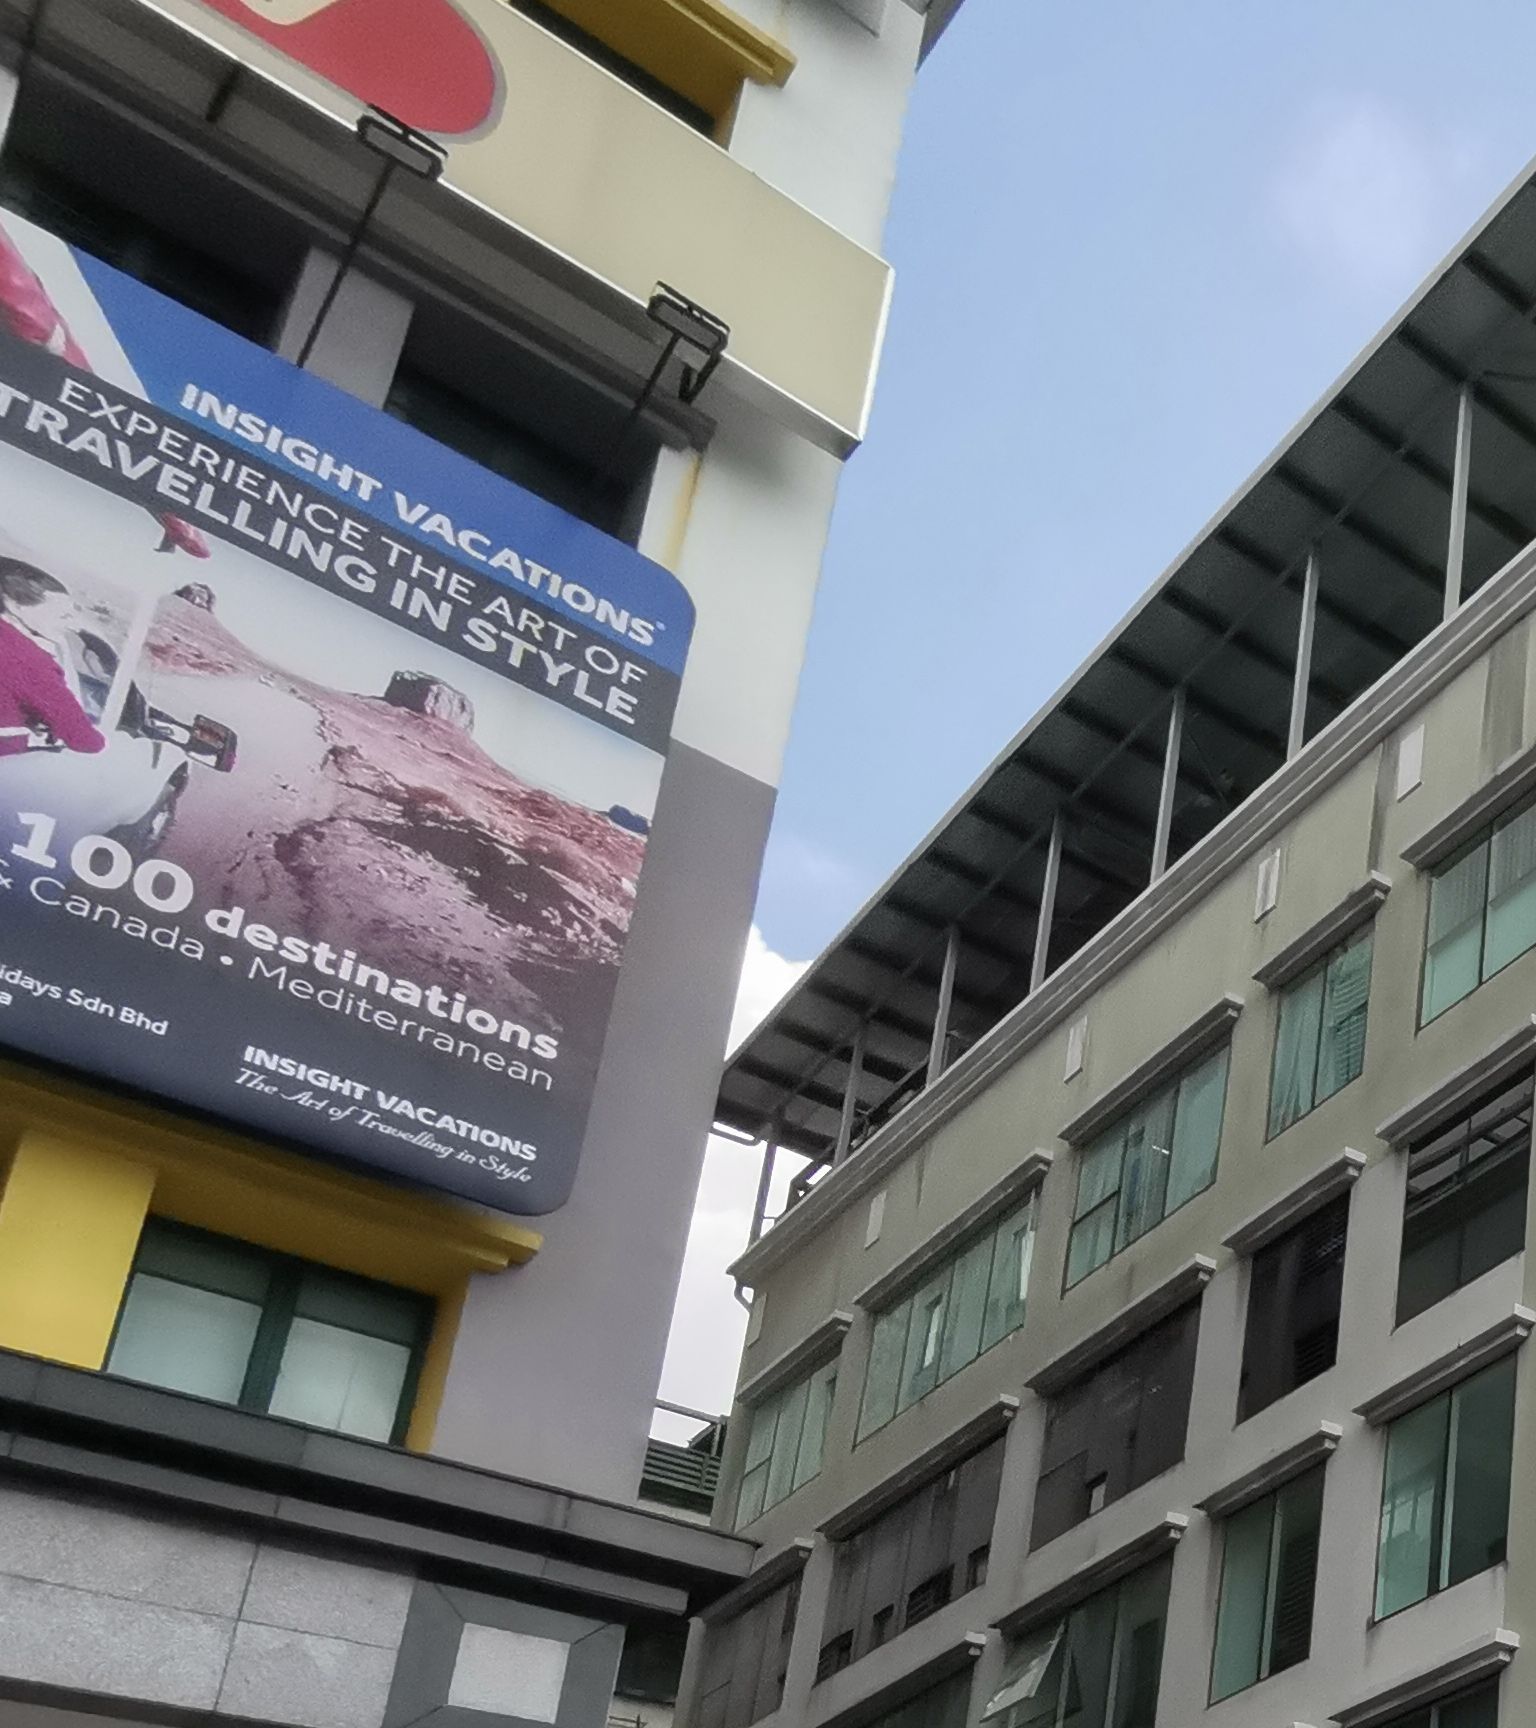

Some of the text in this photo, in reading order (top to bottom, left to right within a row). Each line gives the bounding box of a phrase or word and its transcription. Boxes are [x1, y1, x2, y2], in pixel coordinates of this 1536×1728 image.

[0, 382, 639, 725] TRAVELLING IN STYLE
[59, 378, 647, 685] EXPERIENCE THE ART OF
[180, 383, 655, 647] INSIGHT VACATIONS
[11, 811, 560, 1060] 100 destinations
[30, 876, 553, 1091] Canada Mediterranean
[66, 988, 115, 1018] Sdn
[119, 1006, 169, 1036] Bhd
[235, 1067, 533, 1183] The Art of Travelling in Style
[243, 1045, 538, 1161] INSIGHT VACATIONS
